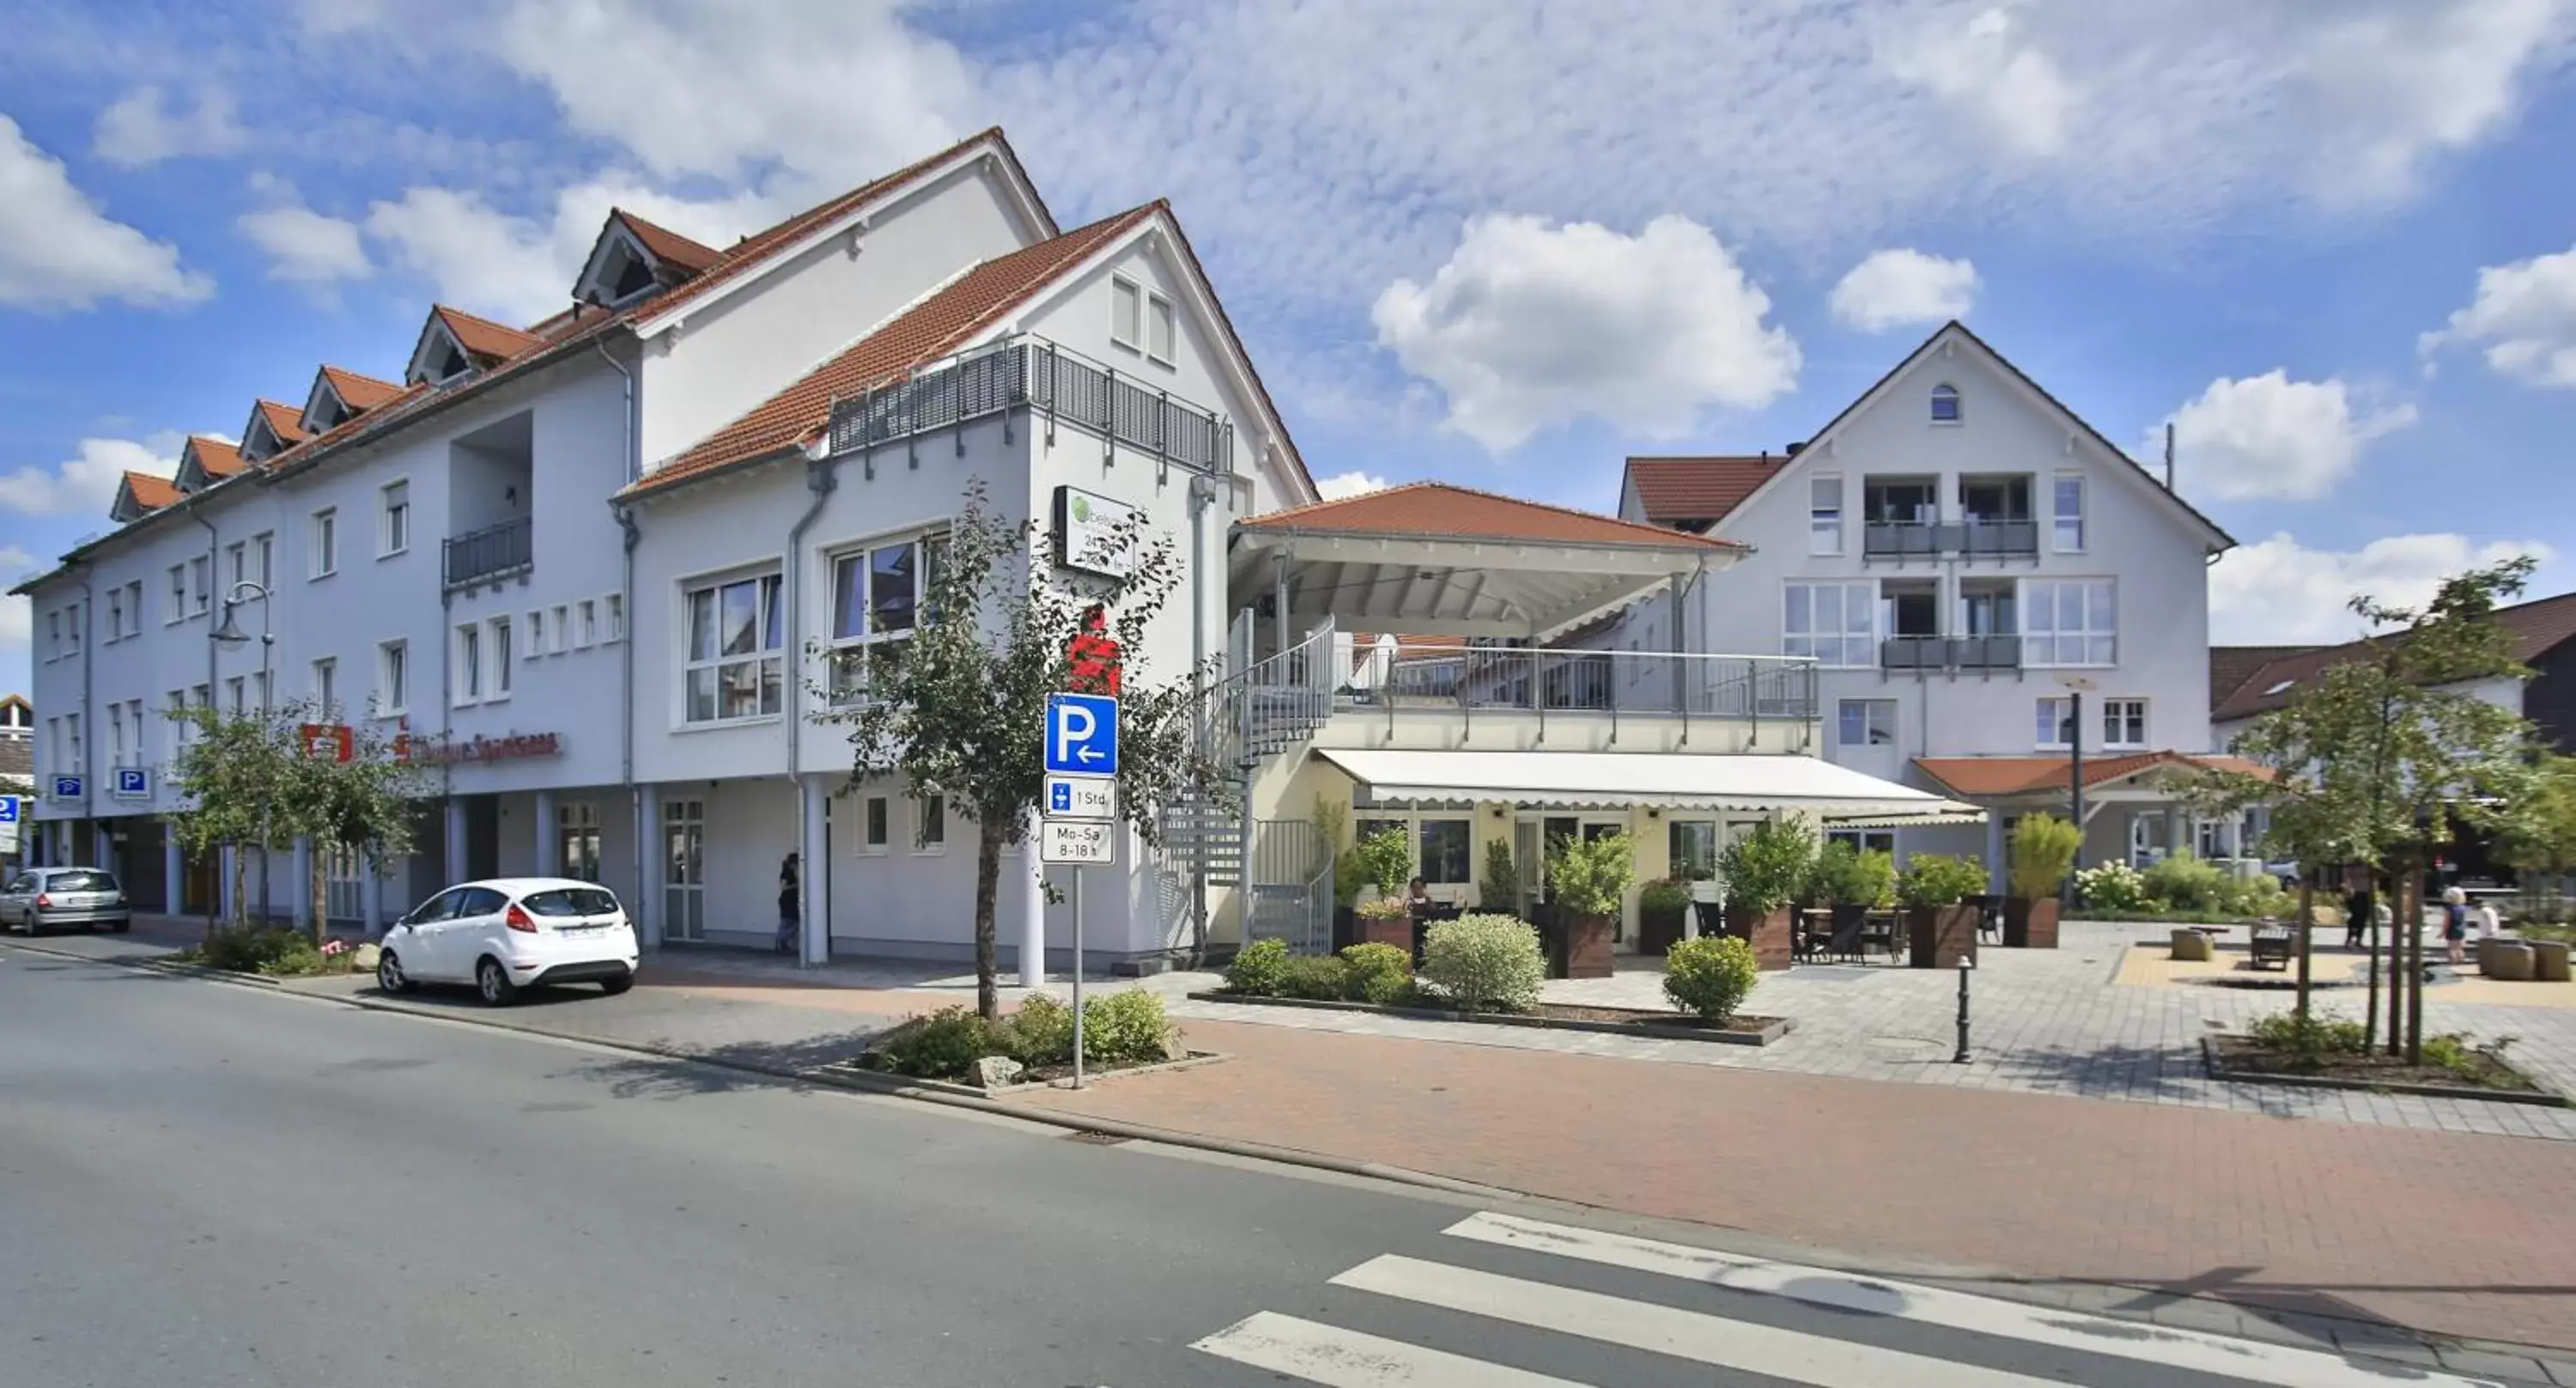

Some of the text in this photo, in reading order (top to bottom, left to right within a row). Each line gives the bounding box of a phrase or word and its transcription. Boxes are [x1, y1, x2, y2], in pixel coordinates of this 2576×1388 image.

[1057, 704, 1096, 762] P
[125, 773, 140, 788] P
[1076, 790, 1082, 806] 1
[1057, 827, 1100, 841] Mo-Sa
[1060, 844, 1088, 857] 8-18
